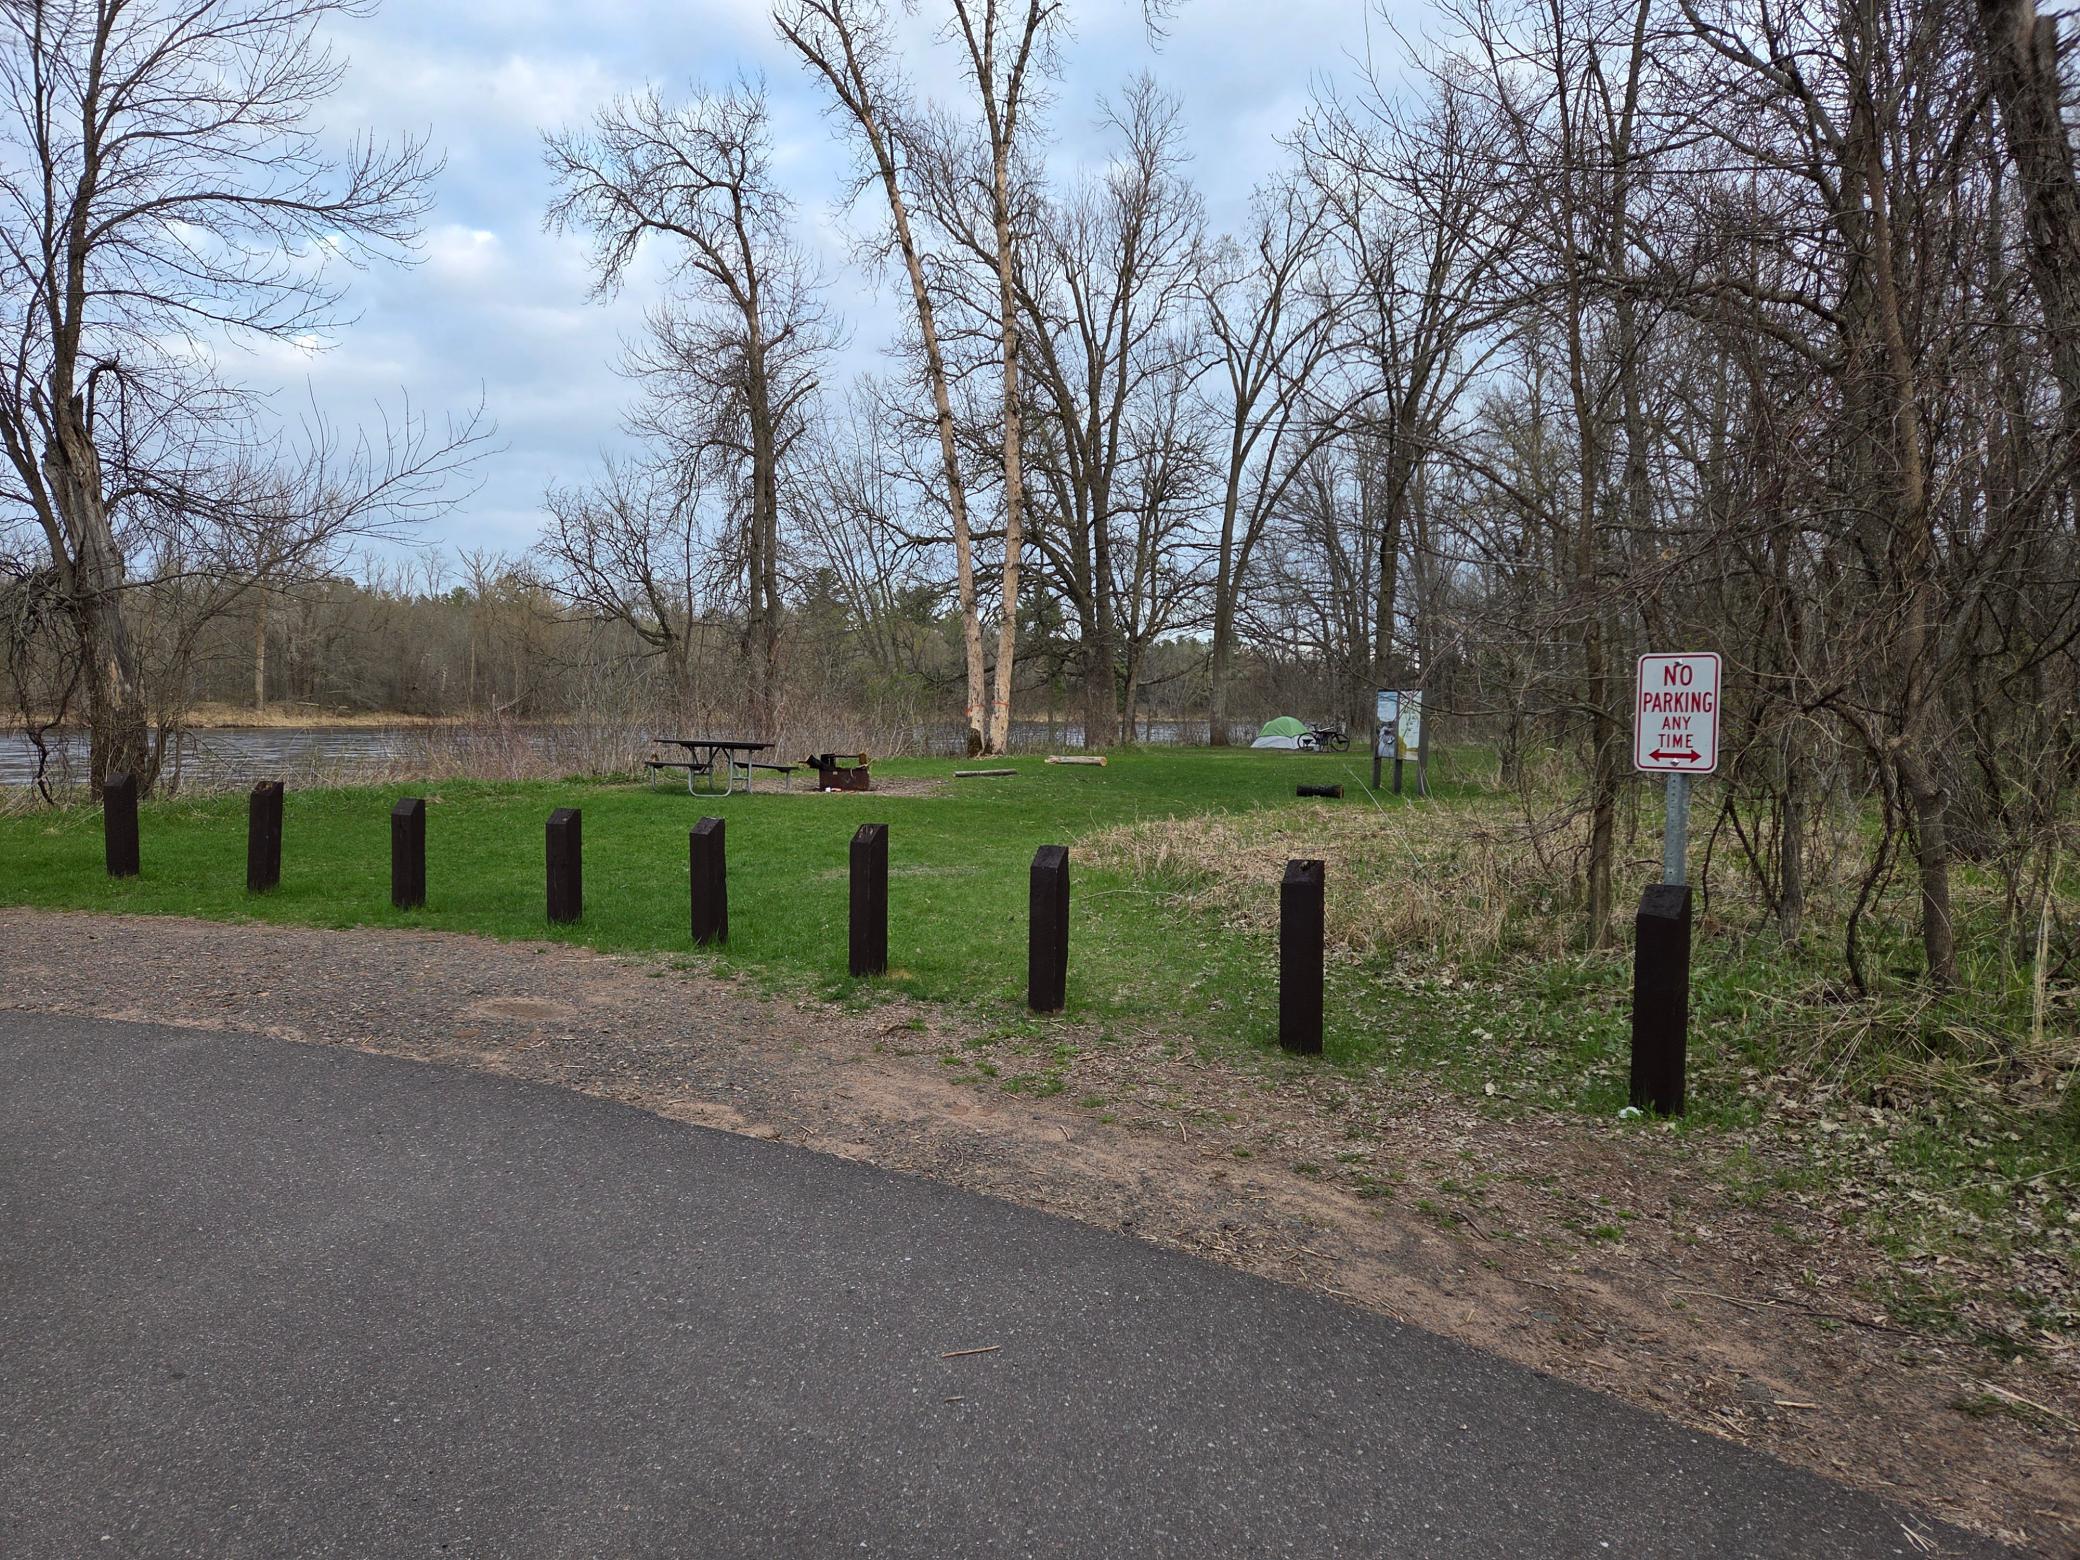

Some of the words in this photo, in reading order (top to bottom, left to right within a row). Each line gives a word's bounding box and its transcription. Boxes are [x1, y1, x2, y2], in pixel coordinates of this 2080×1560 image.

[1664, 665, 1692, 686] NO
[1643, 691, 1712, 712] PARKING
[1662, 716, 1691, 730] ANY
[1658, 734, 1694, 748] TIME
